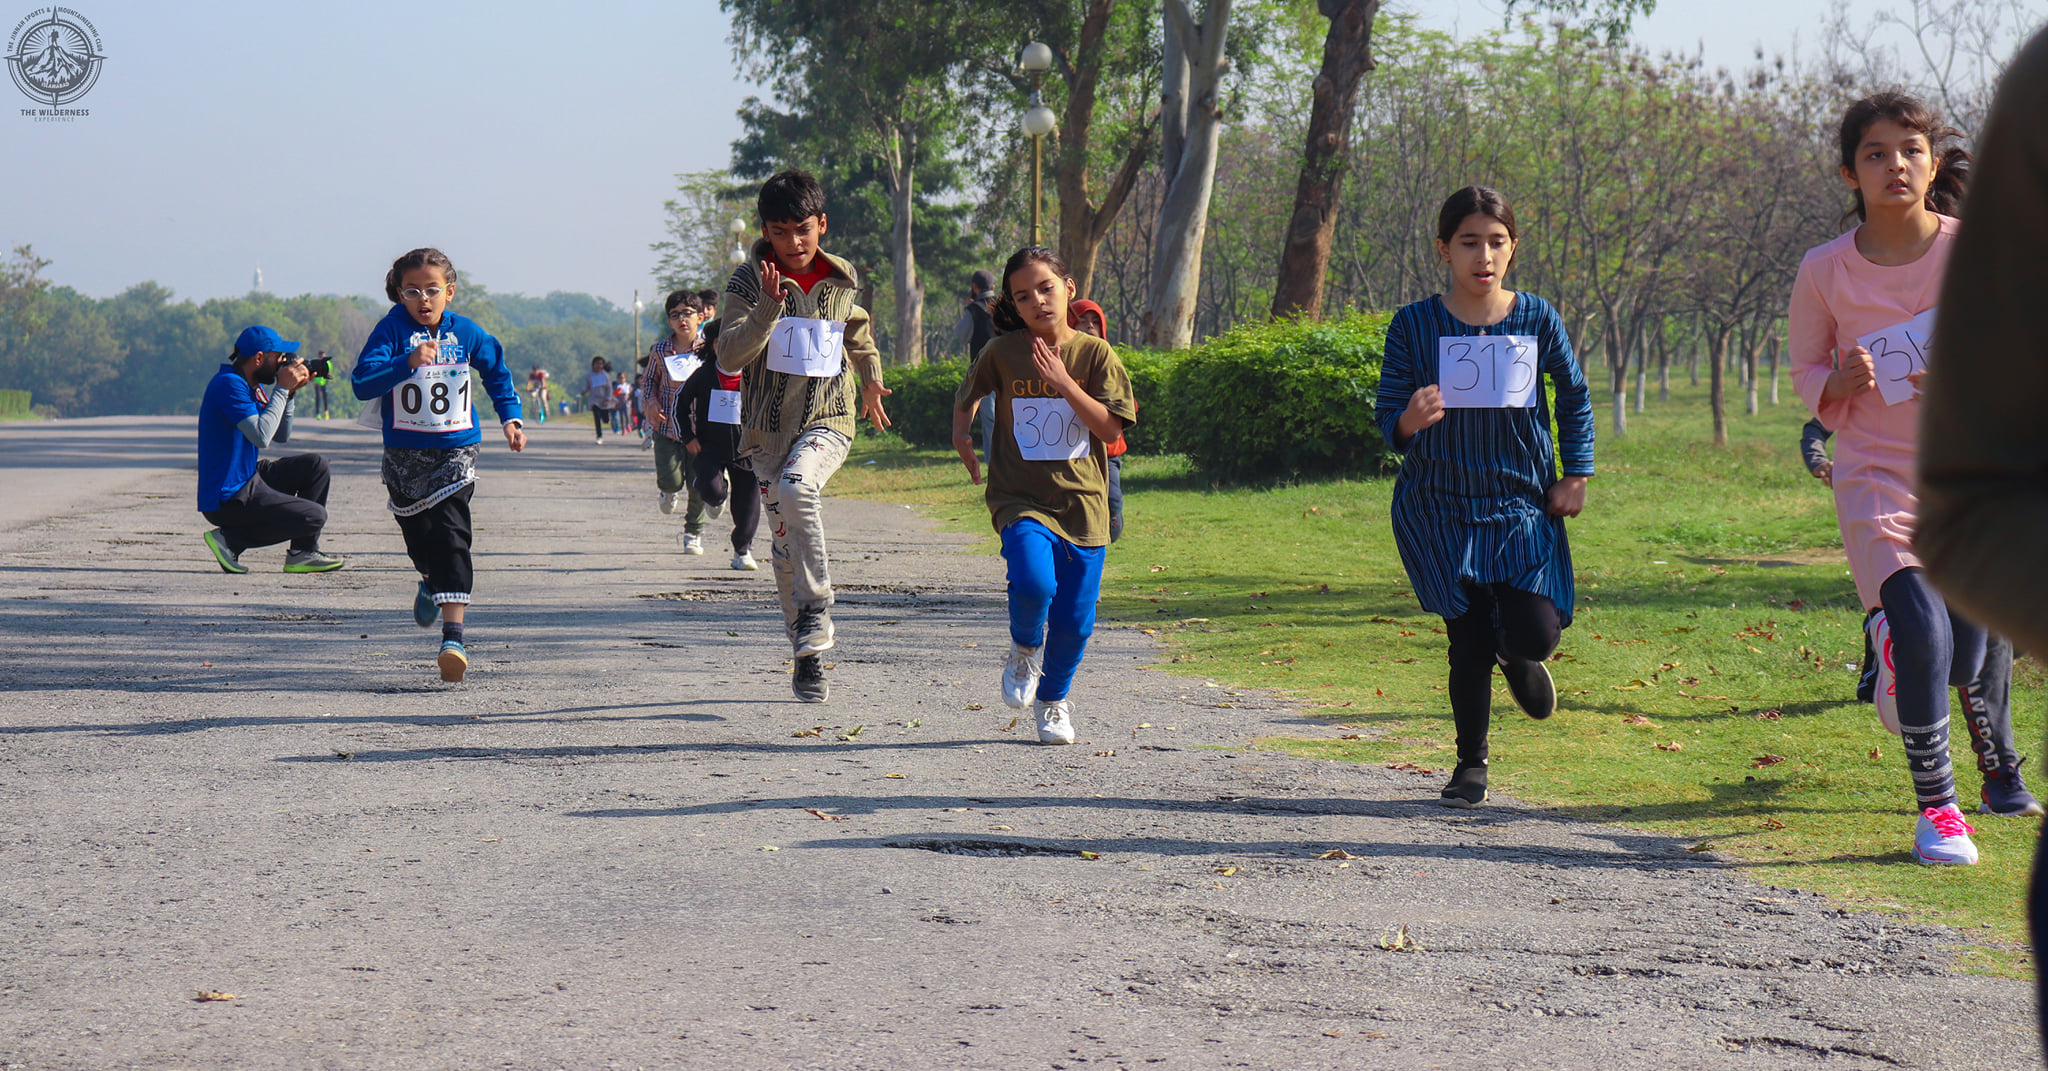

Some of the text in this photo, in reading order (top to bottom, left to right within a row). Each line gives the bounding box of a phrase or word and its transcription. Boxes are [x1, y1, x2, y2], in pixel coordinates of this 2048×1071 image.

[1447, 342, 1532, 393] 313
[401, 379, 469, 415] 081
[1022, 406, 1080, 449] 306
